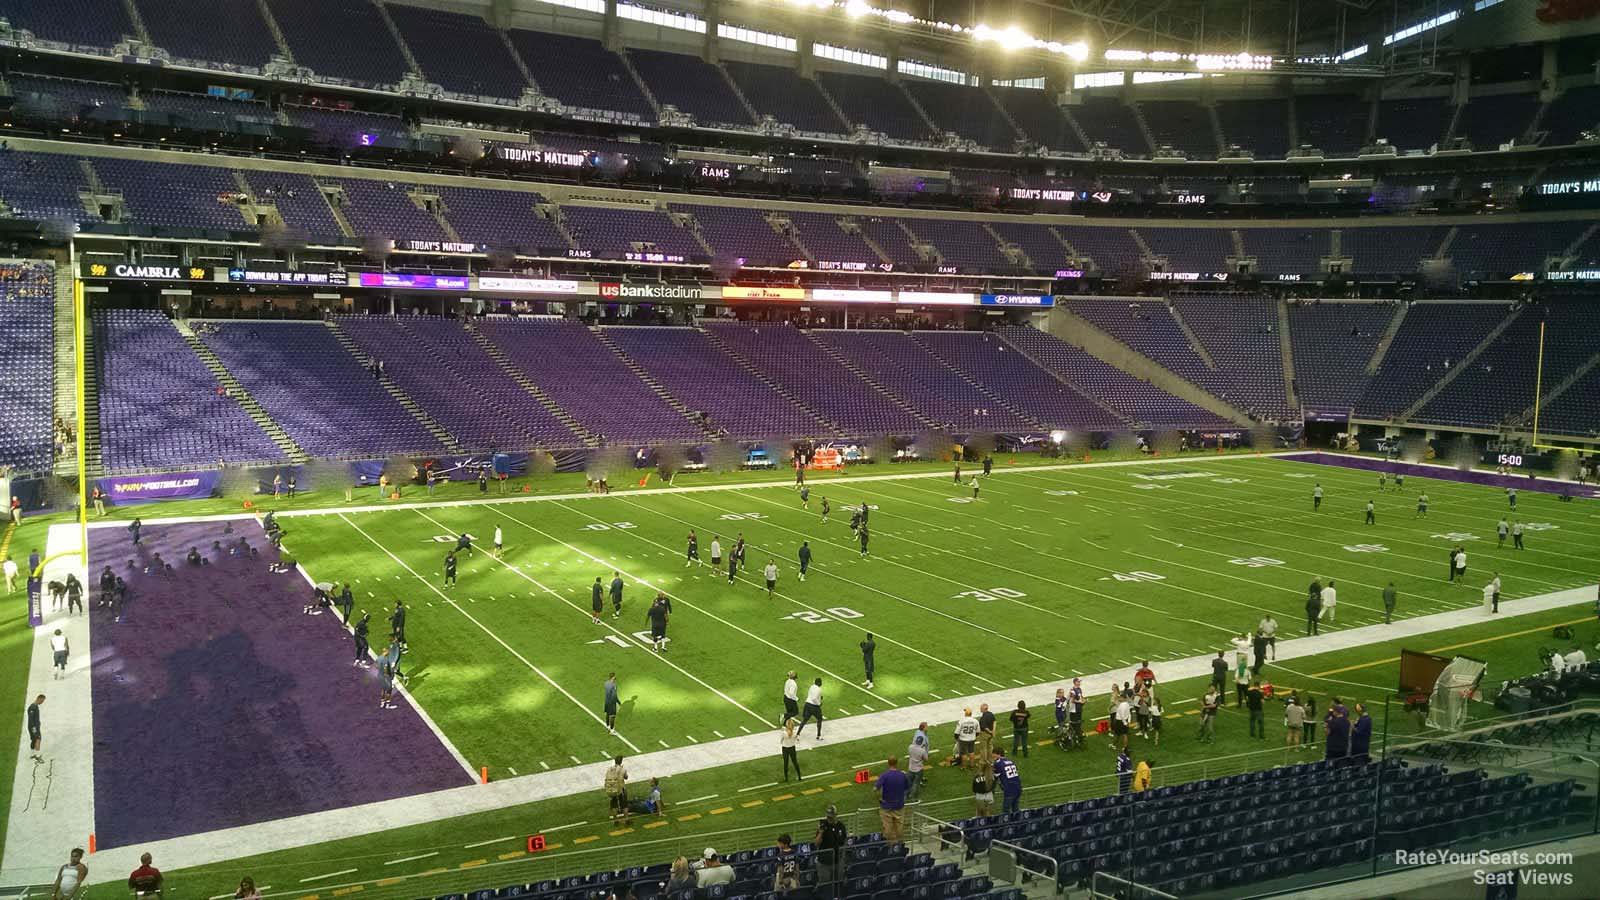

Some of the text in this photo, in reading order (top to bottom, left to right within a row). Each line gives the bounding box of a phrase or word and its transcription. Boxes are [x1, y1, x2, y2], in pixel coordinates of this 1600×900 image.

[504, 147, 584, 166] TODAY'S MATCHUP
[701, 167, 730, 179] RAMS
[1013, 188, 1075, 200] TODAY'S MATCHUP
[1542, 182, 1580, 194] TODAY'S
[1178, 194, 1205, 204] RAMS
[411, 240, 475, 252] TODAY'S MATCHUP
[568, 250, 591, 258] RAMS
[819, 260, 840, 269] TODAY'S
[938, 266, 957, 274] RAMS
[115, 264, 181, 278] CAMBRIA
[245, 271, 279, 280] DOWNLOAD
[280, 272, 292, 281] THE
[294, 273, 306, 282] APP
[1151, 271, 1172, 279] TODAY'S
[1279, 273, 1301, 281] RAMS
[1547, 271, 1574, 279] TODAY'S
[1008, 296, 1041, 304] HYUNDAI
[1498, 454, 1522, 466] 15:00
[1112, 571, 1167, 583] 40
[960, 587, 1028, 602] 30
[792, 607, 865, 624] 20
[1004, 765, 1019, 779] 22
[531, 837, 544, 849] G
